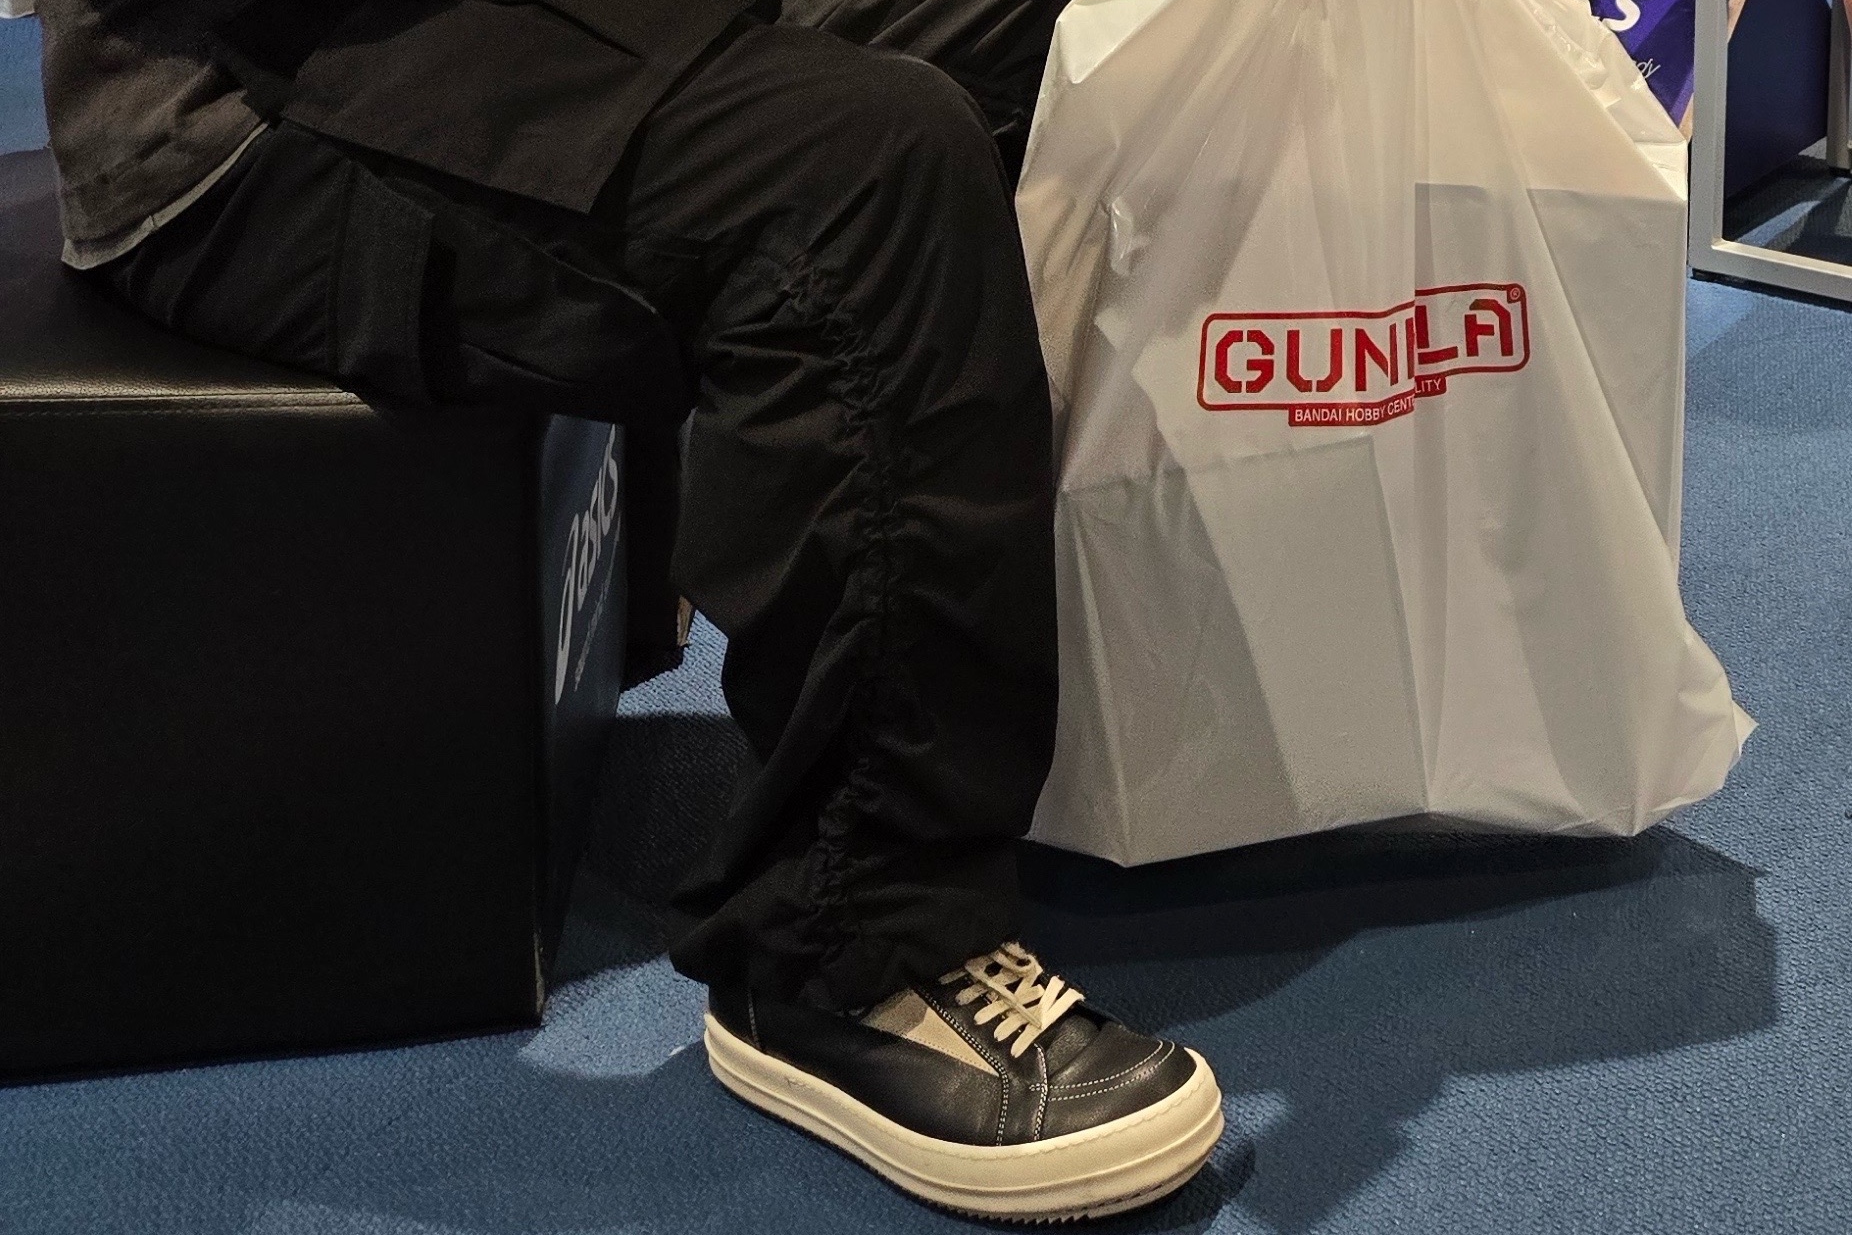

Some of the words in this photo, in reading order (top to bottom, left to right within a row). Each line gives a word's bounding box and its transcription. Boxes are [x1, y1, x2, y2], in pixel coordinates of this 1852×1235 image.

[1215, 298, 1514, 394] GUNLA
[1295, 408, 1343, 423] BANDAI
[1346, 404, 1388, 422] HOBBY
[1415, 378, 1442, 394] LITY
